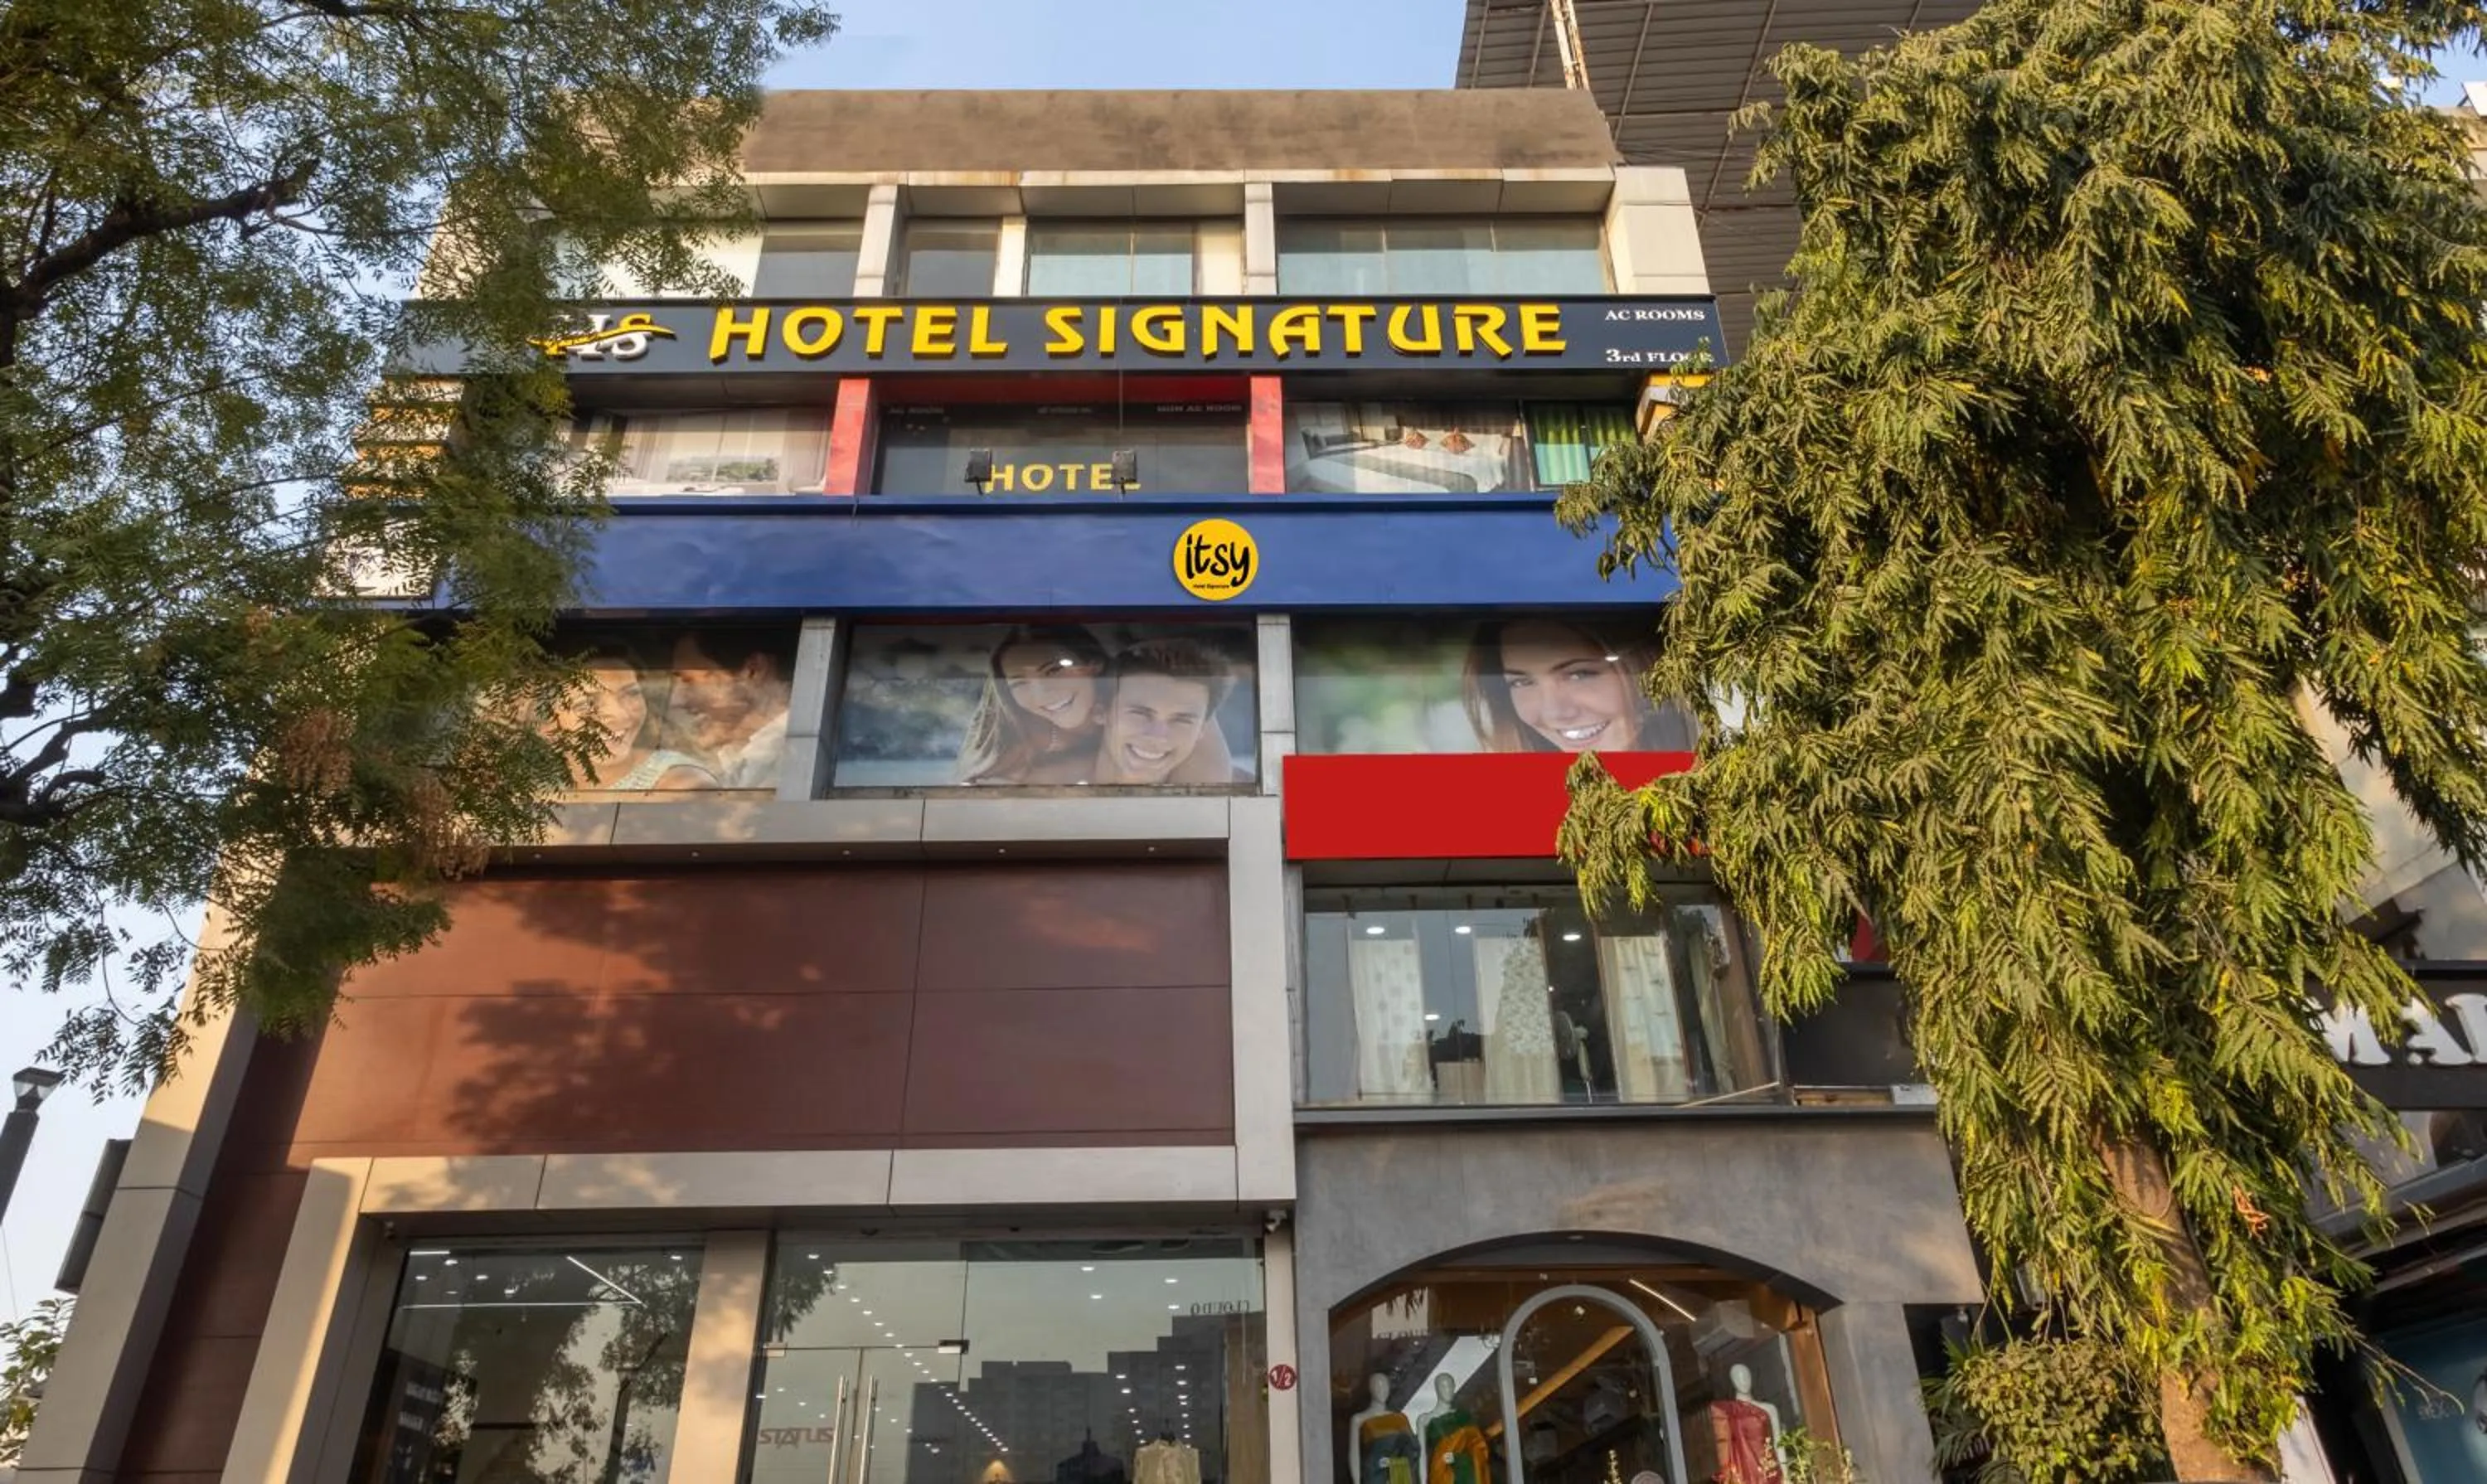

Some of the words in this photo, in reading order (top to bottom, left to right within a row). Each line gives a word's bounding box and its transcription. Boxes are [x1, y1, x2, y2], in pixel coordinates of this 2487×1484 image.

[1605, 309, 1631, 320] AC
[1635, 309, 1705, 320] ROOMS
[709, 305, 1009, 365] HOTEL
[1045, 304, 1568, 361] SIGNATURE
[1606, 348, 1641, 362] 3rd
[1185, 533, 1250, 588] itsy
[759, 1426, 834, 1449] STATUS
